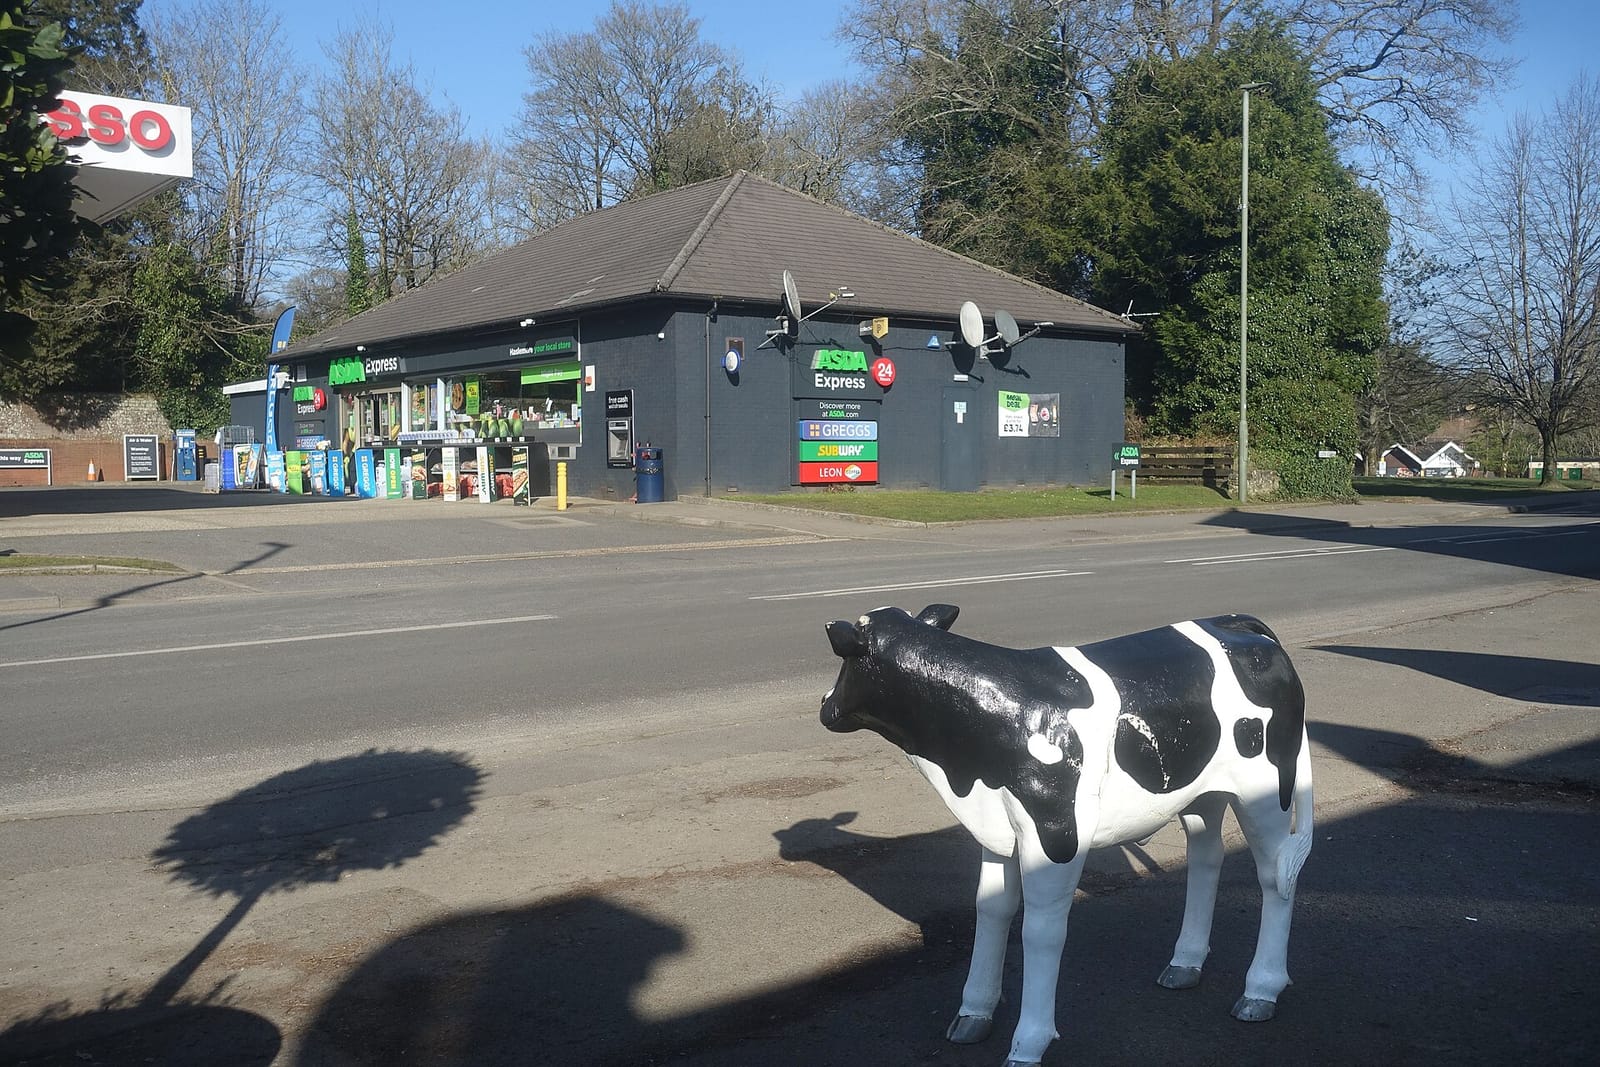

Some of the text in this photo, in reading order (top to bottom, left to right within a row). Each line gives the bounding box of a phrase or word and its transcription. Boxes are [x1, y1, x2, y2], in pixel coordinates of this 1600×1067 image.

[534, 344, 546, 354] your
[546, 342, 558, 351] local
[558, 341, 571, 350] store
[810, 349, 868, 371] ASDA
[328, 356, 398, 386] ASDA Express
[878, 362, 893, 377] 24
[814, 373, 866, 391] Express
[617, 395, 628, 403] cash
[297, 403, 316, 415] Express
[828, 410, 859, 418] ASDA.com
[822, 424, 871, 437] GREGGS
[817, 445, 864, 456] SUBWAY
[1120, 447, 1139, 457] ASDA
[1120, 457, 1139, 466] Express
[362, 463, 370, 491] GREGGS
[819, 467, 842, 477] LEON
